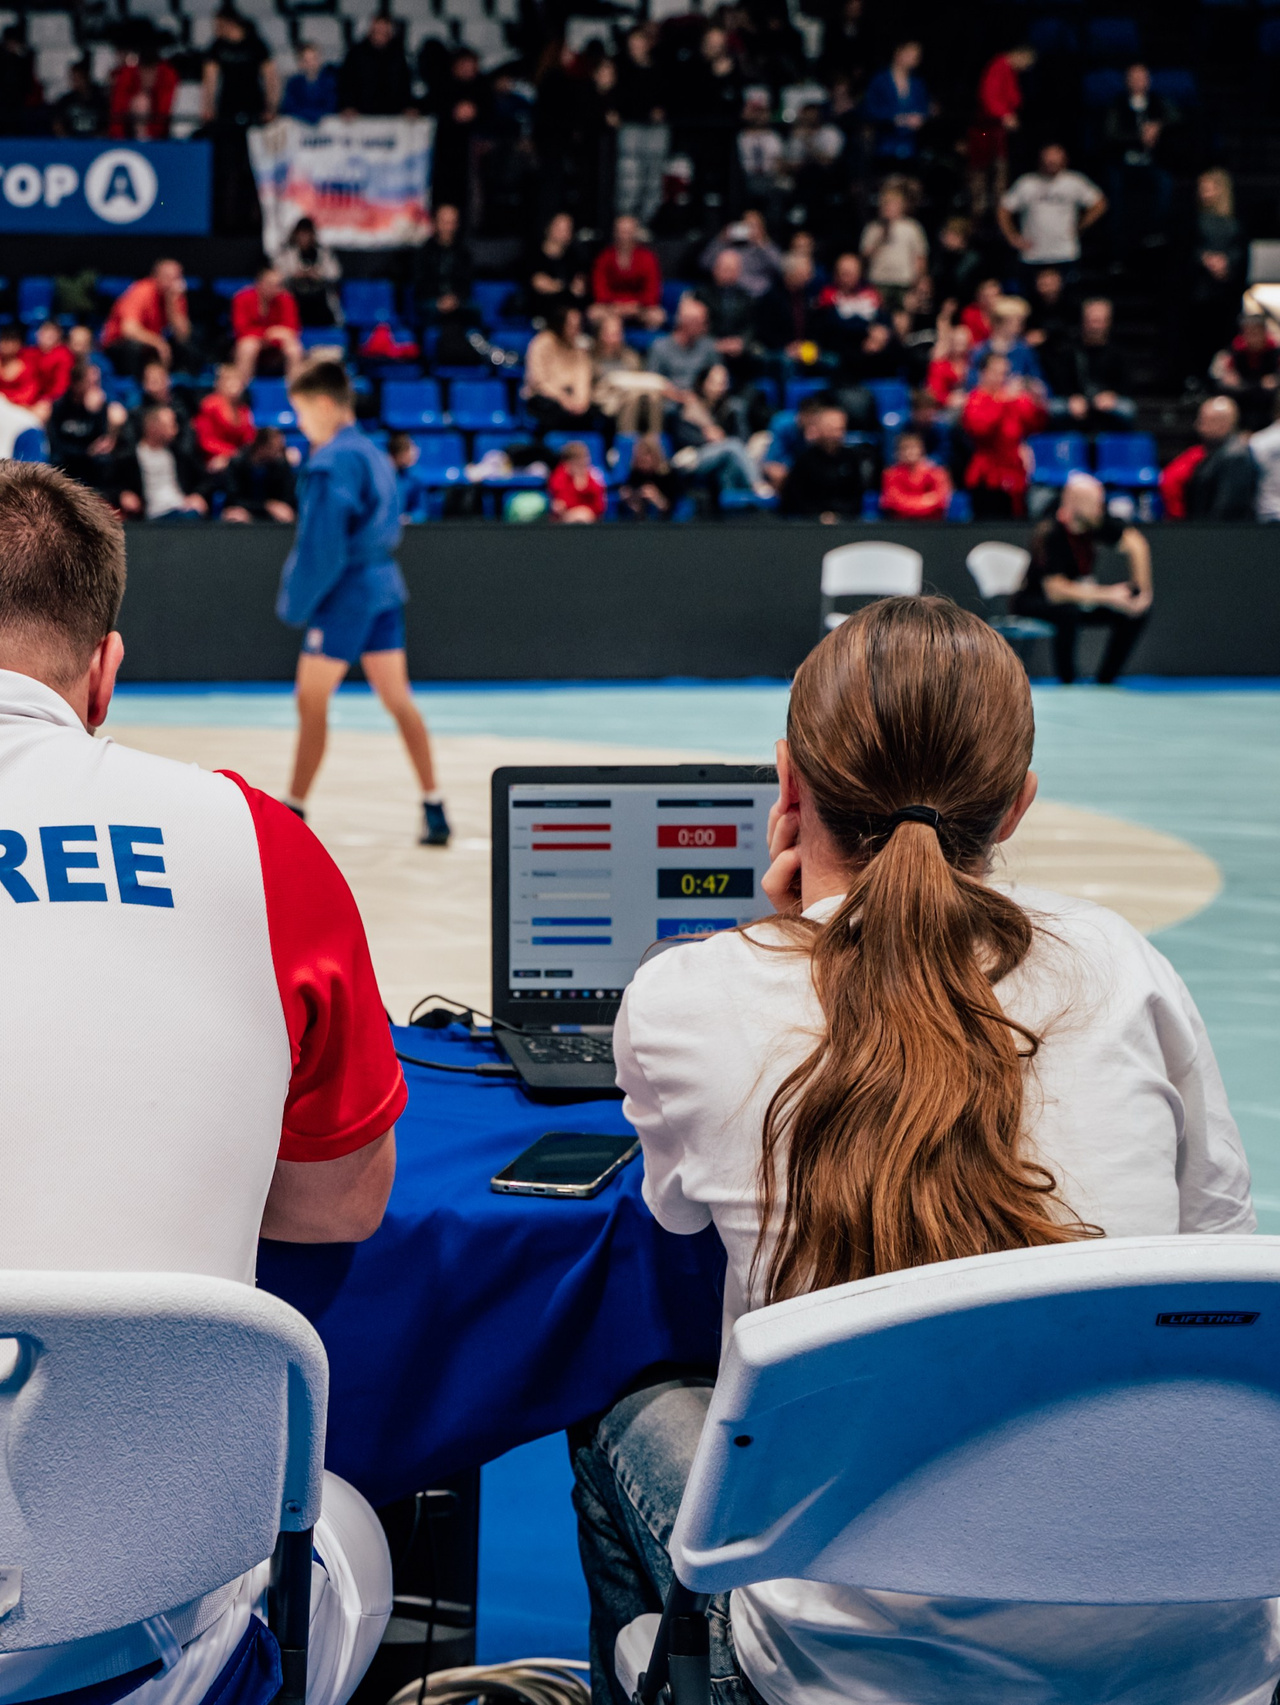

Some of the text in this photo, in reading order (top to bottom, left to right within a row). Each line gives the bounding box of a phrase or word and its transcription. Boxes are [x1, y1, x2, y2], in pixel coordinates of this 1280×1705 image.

[678, 828, 716, 846] 0:00
[681, 873, 730, 895] 0:47
[1169, 1315, 1244, 1323] LIFETIME
